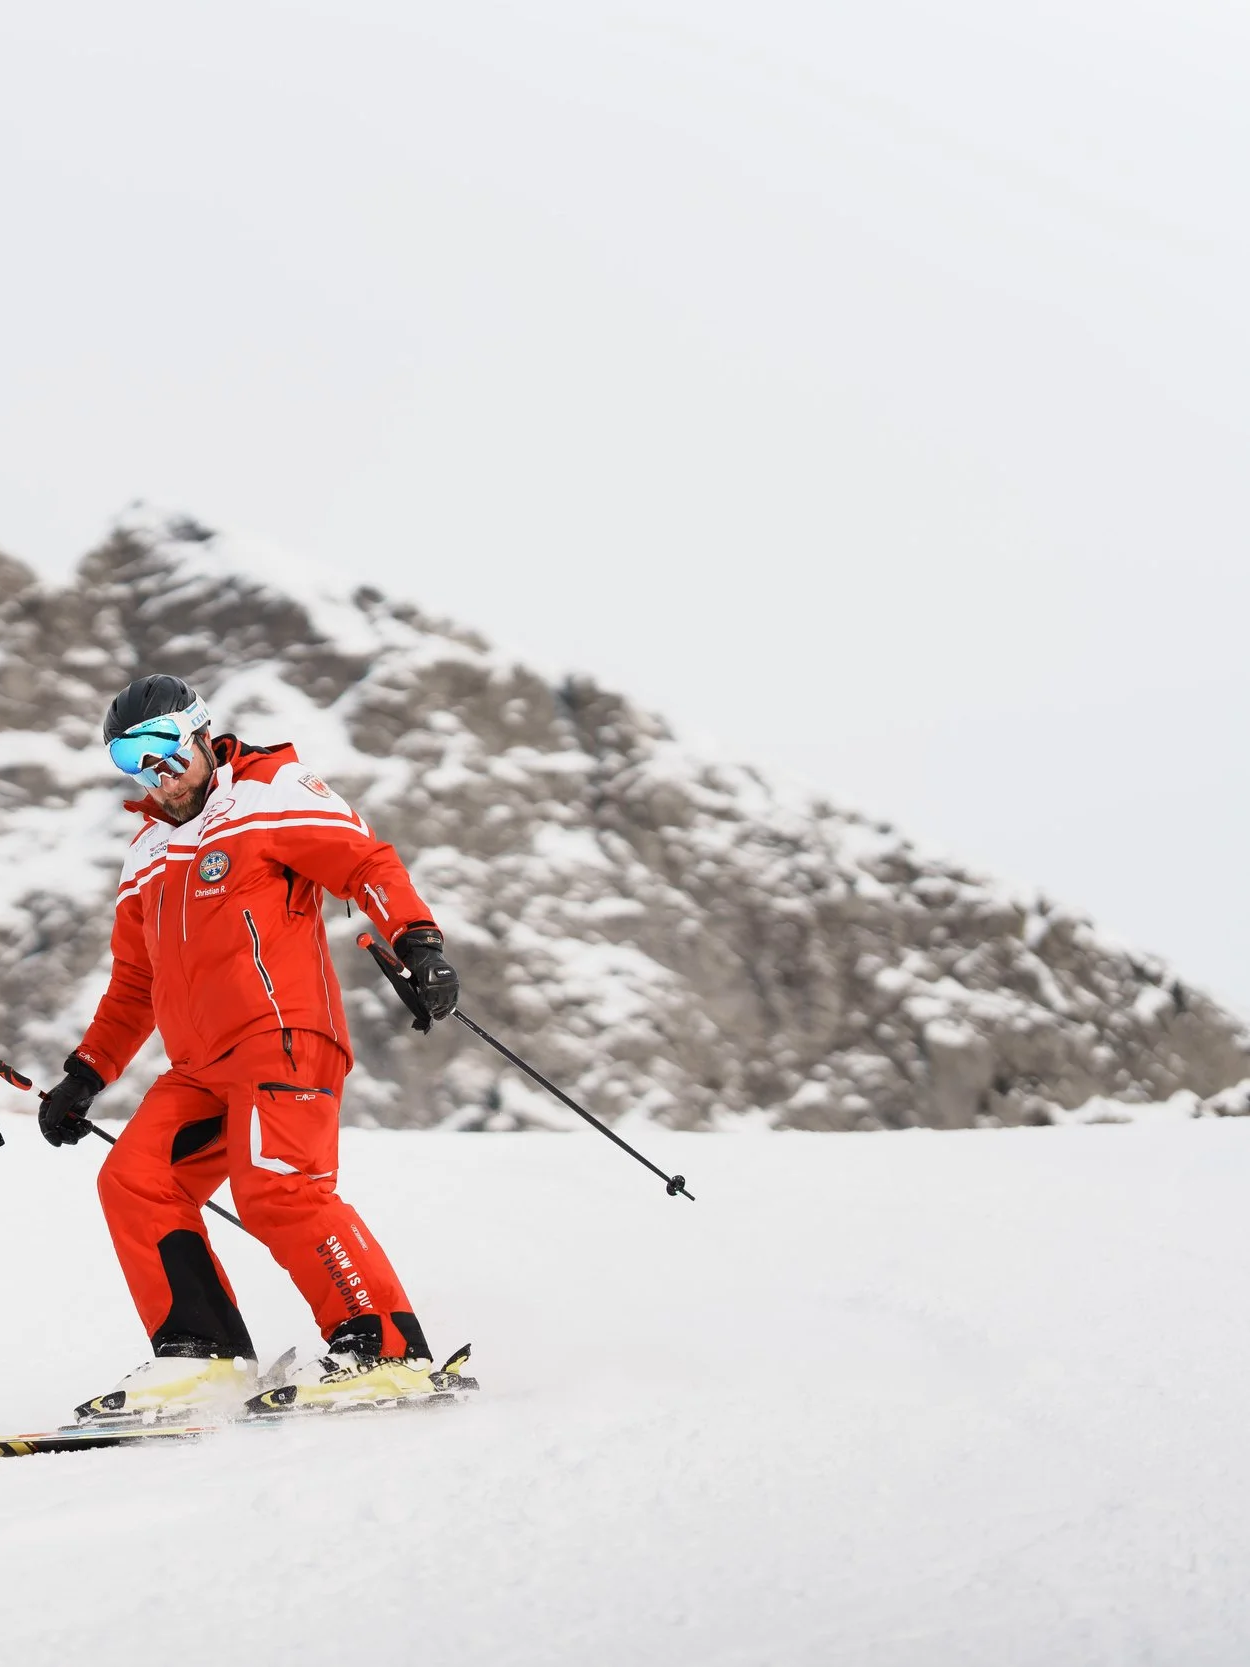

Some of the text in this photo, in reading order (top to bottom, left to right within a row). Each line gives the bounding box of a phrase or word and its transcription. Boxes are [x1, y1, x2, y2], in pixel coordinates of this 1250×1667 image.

[195, 888, 220, 898] Christian
[326, 1235, 353, 1270] SNOW
[346, 1271, 362, 1287] IS
